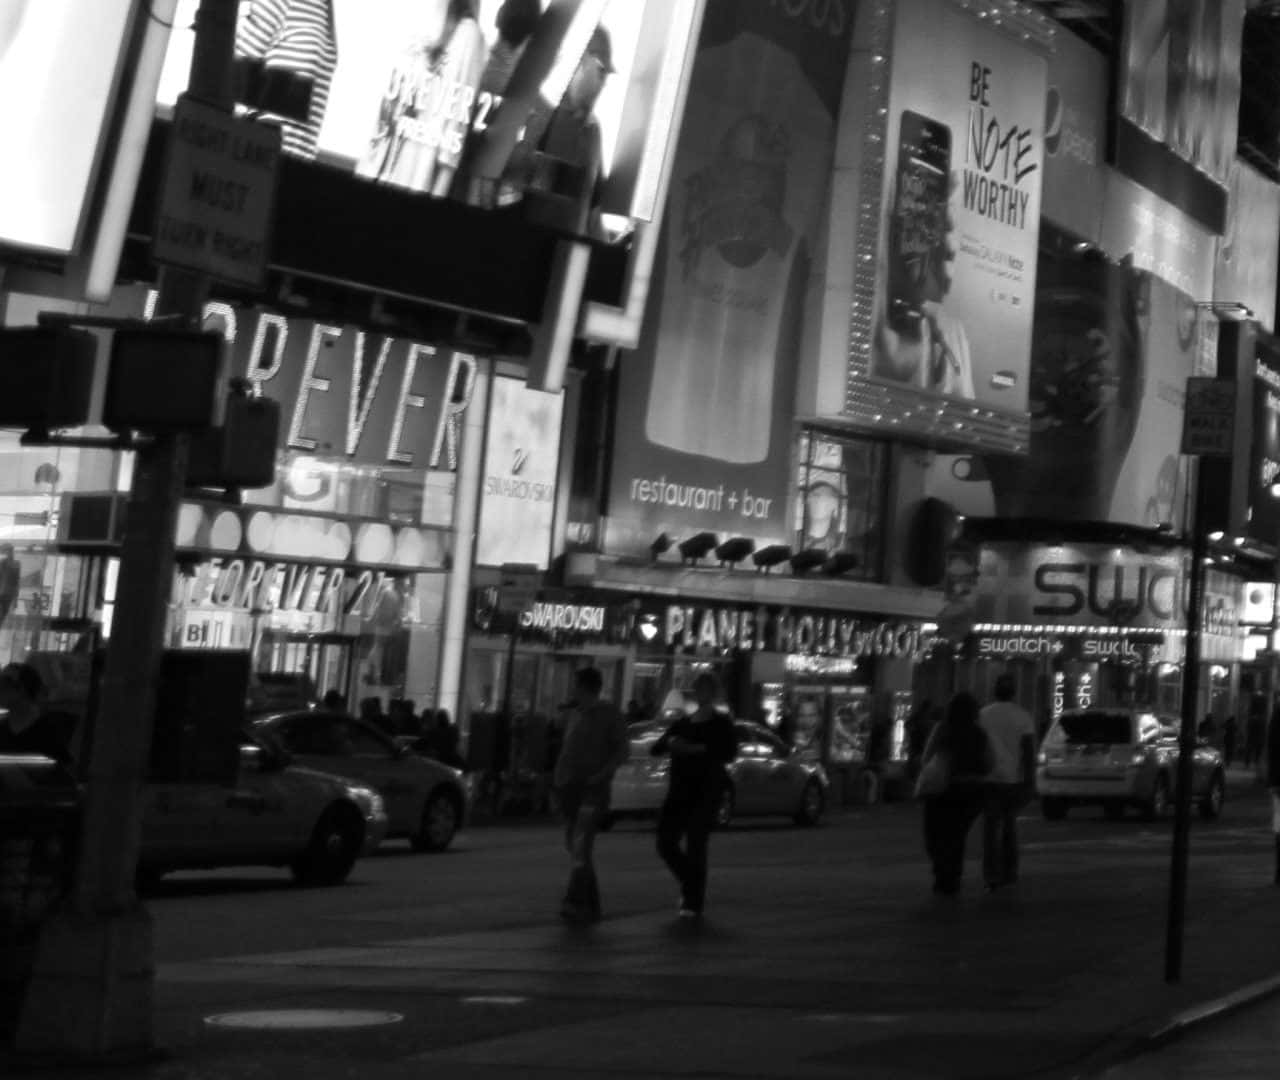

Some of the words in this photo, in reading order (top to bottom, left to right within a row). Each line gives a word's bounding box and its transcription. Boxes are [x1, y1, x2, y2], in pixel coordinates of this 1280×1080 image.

[969, 60, 993, 108] BE
[966, 104, 1038, 185] NOTE
[189, 170, 253, 213] MUST
[962, 167, 1031, 231] WORTHY
[144, 289, 477, 471] REVER
[486, 475, 554, 503] SWAROVSKI
[630, 474, 725, 513] restaurant
[741, 487, 773, 519] bar
[203, 557, 346, 614] FOREVER
[519, 601, 606, 632] SWAROVSKI
[664, 604, 766, 650] PLANET
